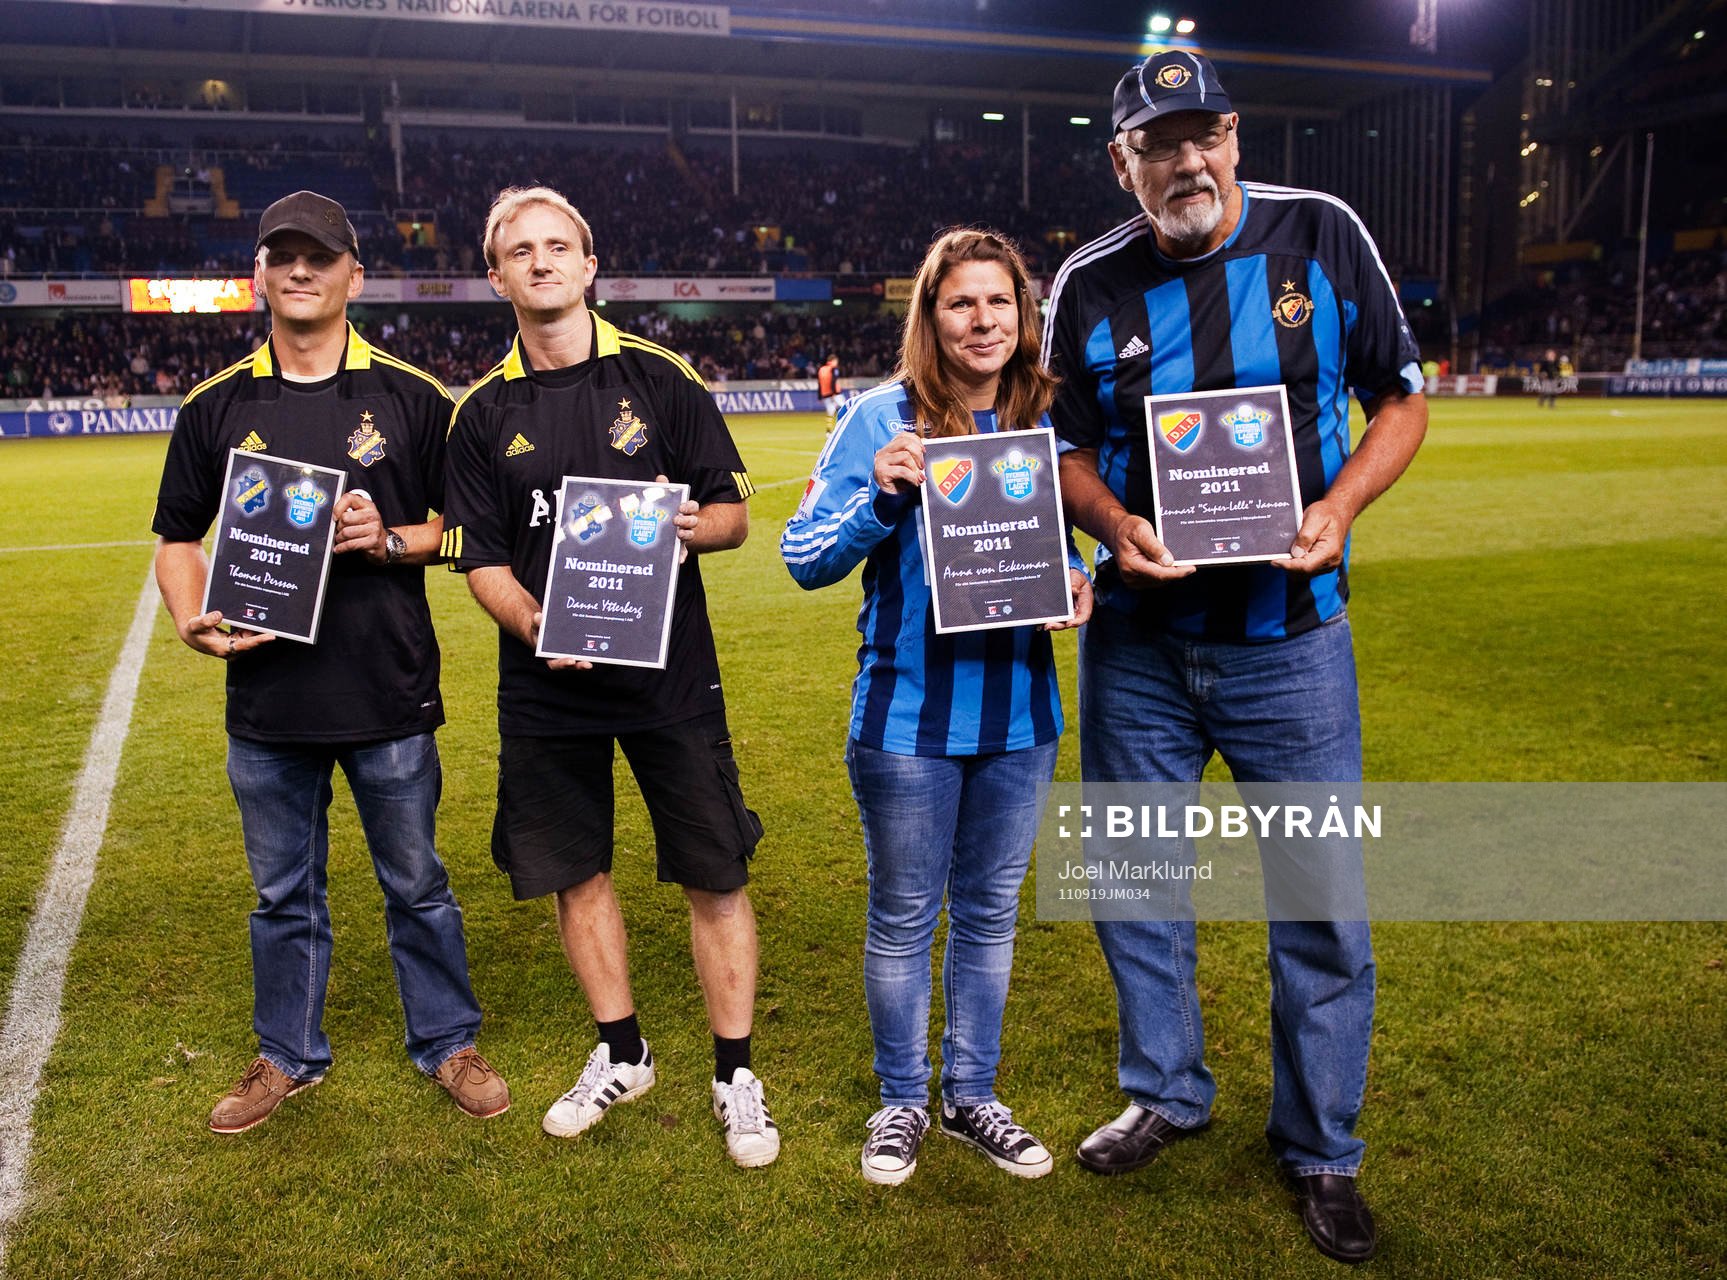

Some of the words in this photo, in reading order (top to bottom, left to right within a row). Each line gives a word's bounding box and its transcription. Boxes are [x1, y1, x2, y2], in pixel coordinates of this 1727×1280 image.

[589, 3, 629, 23] FÖR
[636, 8, 719, 29] FOTBOLL
[674, 282, 702, 297] ICA
[1118, 344, 1149, 359] adidas
[715, 391, 795, 412] PANAXIA
[81, 408, 179, 433] PANAXIA
[505, 443, 536, 457] adidas
[1168, 462, 1271, 481] Nominerad
[1200, 480, 1241, 495] 2011
[941, 516, 1040, 538] Nominerad
[228, 527, 310, 555] Nominerad
[973, 536, 1012, 553] 2011
[250, 548, 282, 565] 2011
[229, 564, 262, 583] Thomas
[564, 557, 654, 576] Nominerad
[943, 565, 973, 579] Anna
[975, 567, 996, 577] von
[998, 559, 1050, 573] Eckerman
[588, 576, 624, 590] 2011
[566, 595, 598, 610] Danne
[602, 599, 644, 620] Ytterberg
